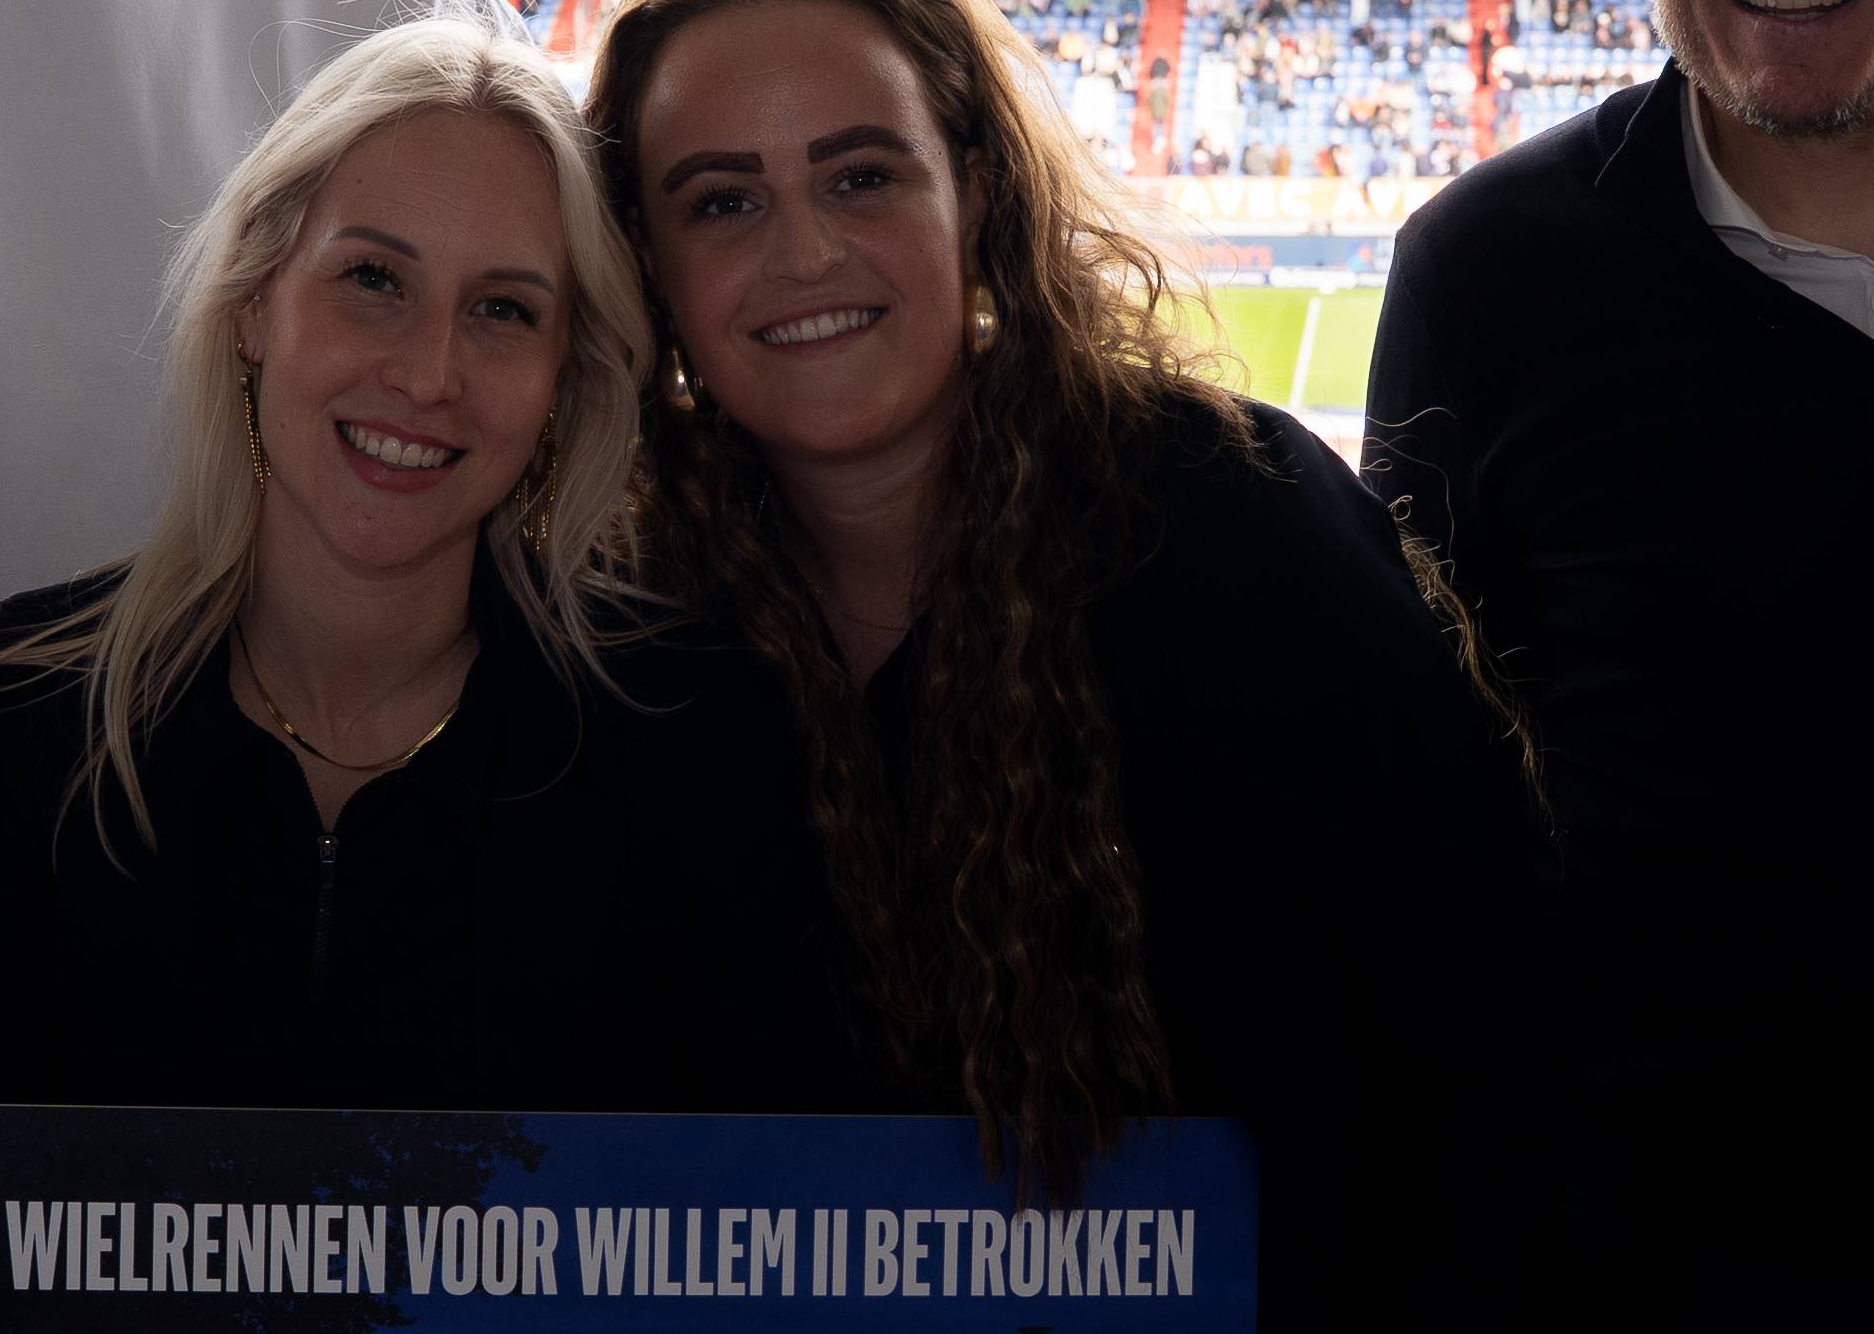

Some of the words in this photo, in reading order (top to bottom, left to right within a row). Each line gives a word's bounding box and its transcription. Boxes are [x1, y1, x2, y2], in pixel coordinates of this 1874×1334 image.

[1177, 179, 1312, 218] AVEC
[4, 1200, 387, 1294] WIELRENNEN
[403, 1205, 559, 1296] VOOR
[574, 1207, 797, 1297] WILLEM
[812, 1208, 849, 1297] II
[863, 1208, 1195, 1298] BETROKKEN
